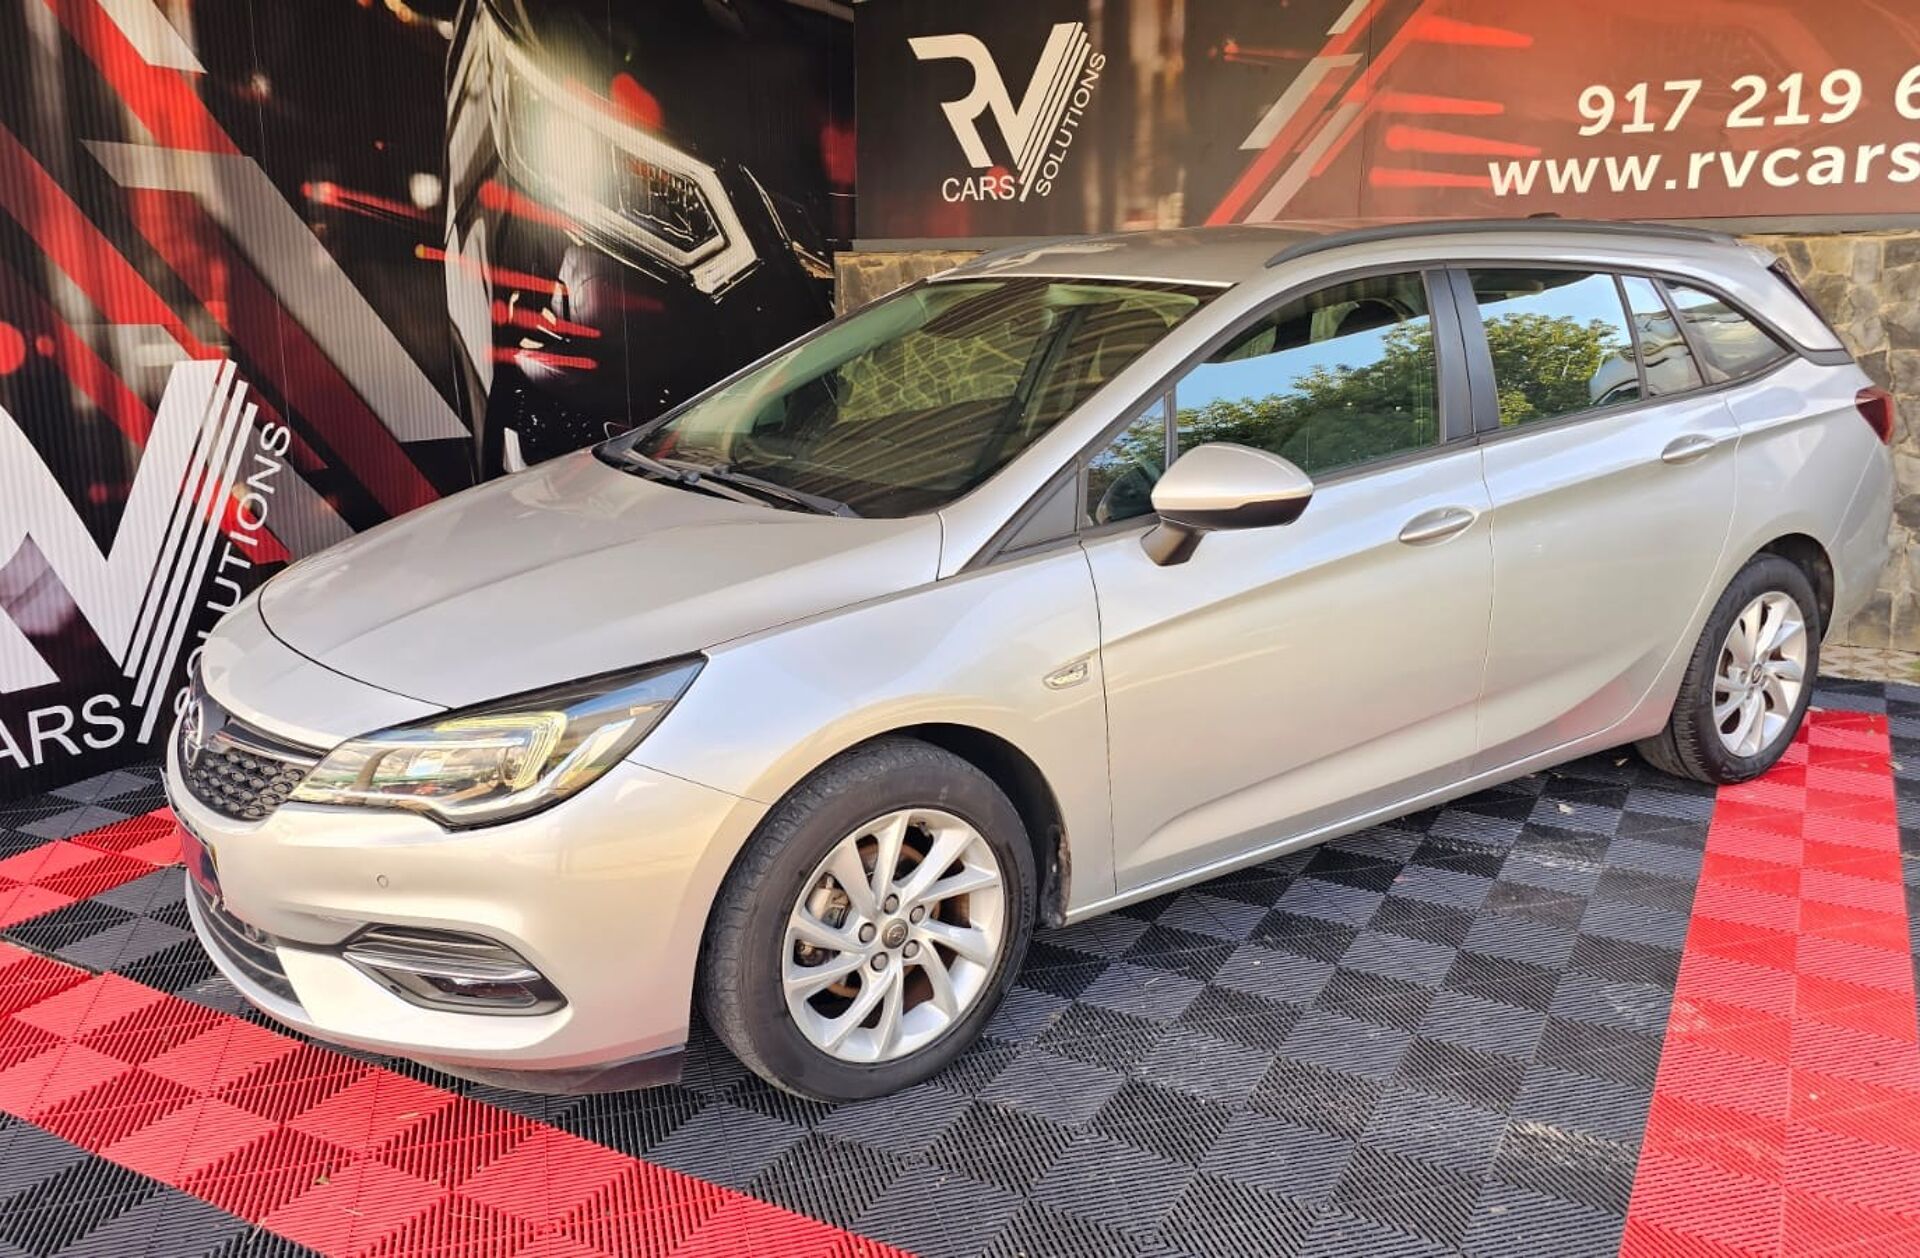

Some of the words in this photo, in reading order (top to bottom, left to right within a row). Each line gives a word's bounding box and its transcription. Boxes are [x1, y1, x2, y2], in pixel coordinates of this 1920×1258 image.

[1036, 51, 1107, 197] SOLUTIONS
[1577, 79, 1702, 136] 917
[1726, 68, 1862, 128] 219
[1895, 64, 1920, 120] 6
[942, 175, 1016, 202] CARS
[1488, 141, 1920, 196] www.rvcars
[174, 421, 291, 717] UTIONS
